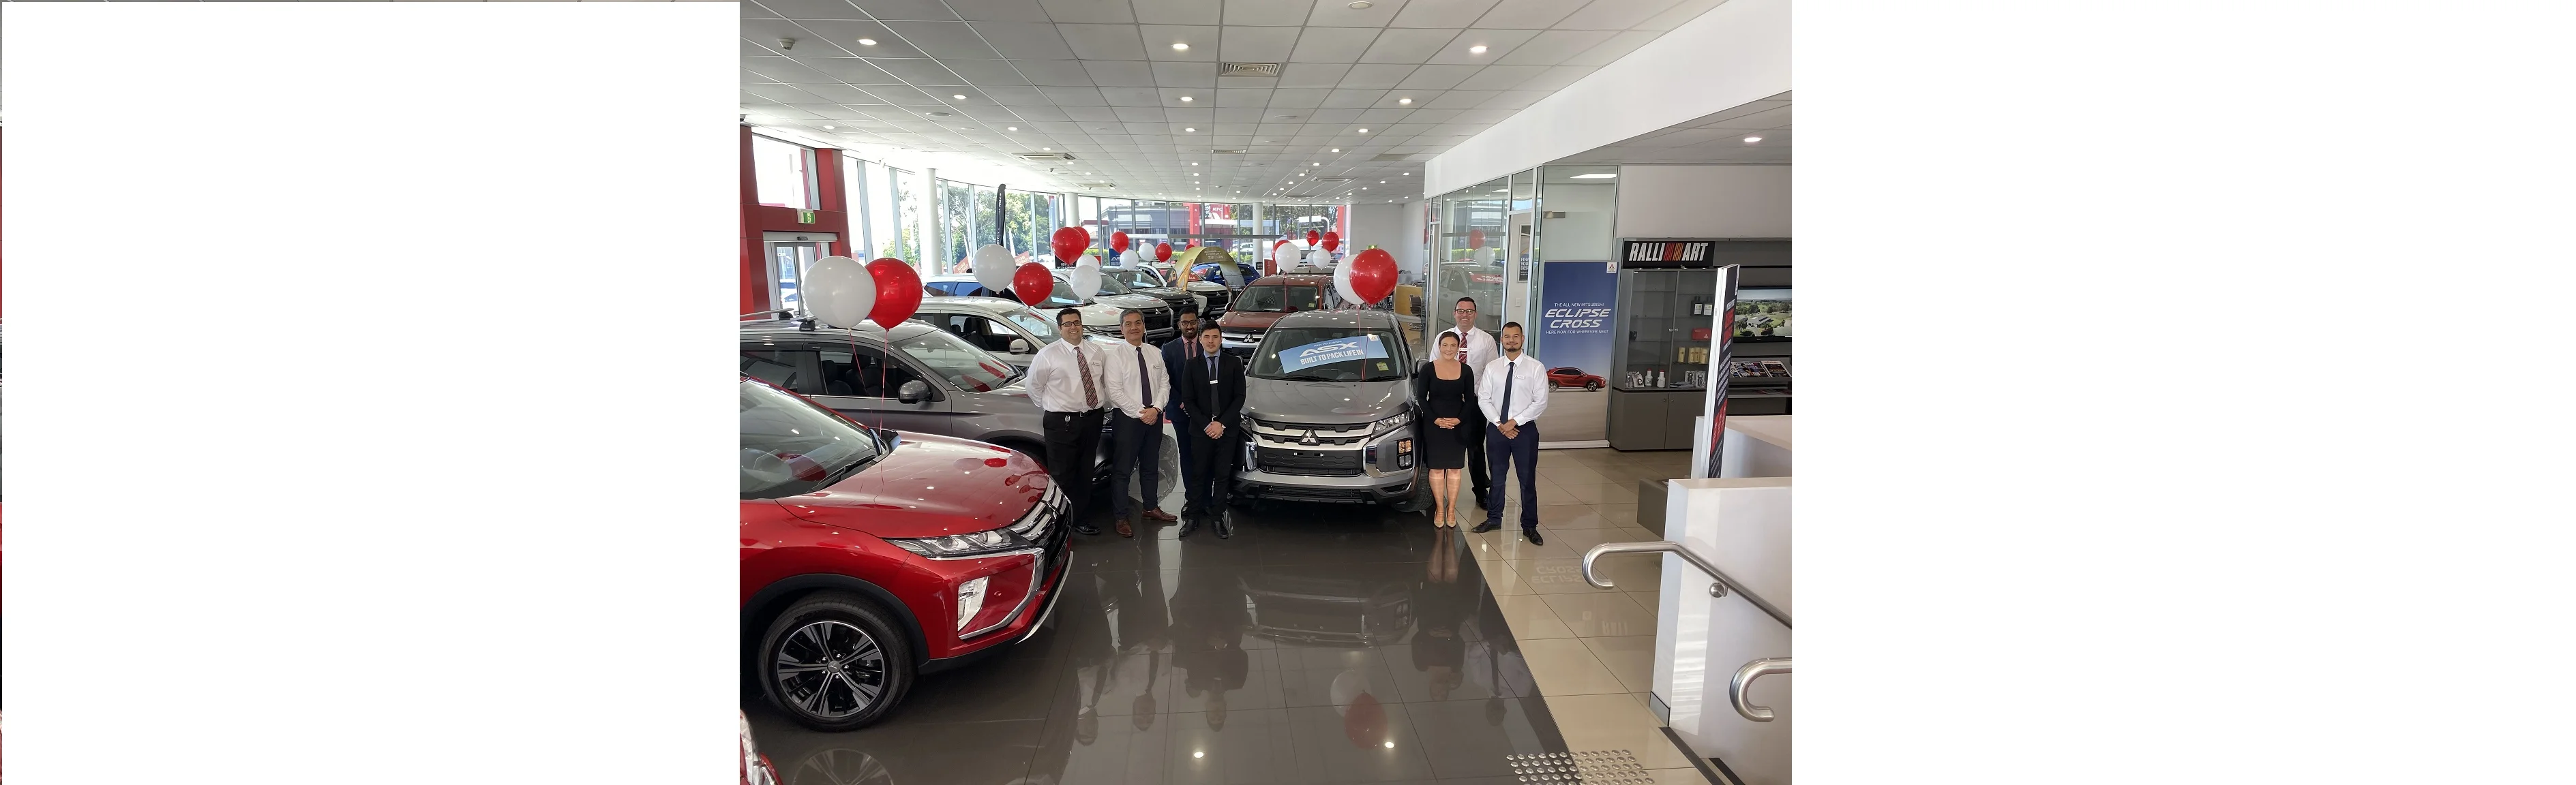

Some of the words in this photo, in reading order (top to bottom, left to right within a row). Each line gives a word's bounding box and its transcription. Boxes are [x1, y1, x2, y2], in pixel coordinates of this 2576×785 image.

[1544, 308, 1612, 318] ECLIPSE
[1550, 319, 1603, 328] CROSS
[1299, 341, 1359, 358] ASX
[1300, 356, 1317, 365] BUILT
[1326, 351, 1344, 360] PACK
